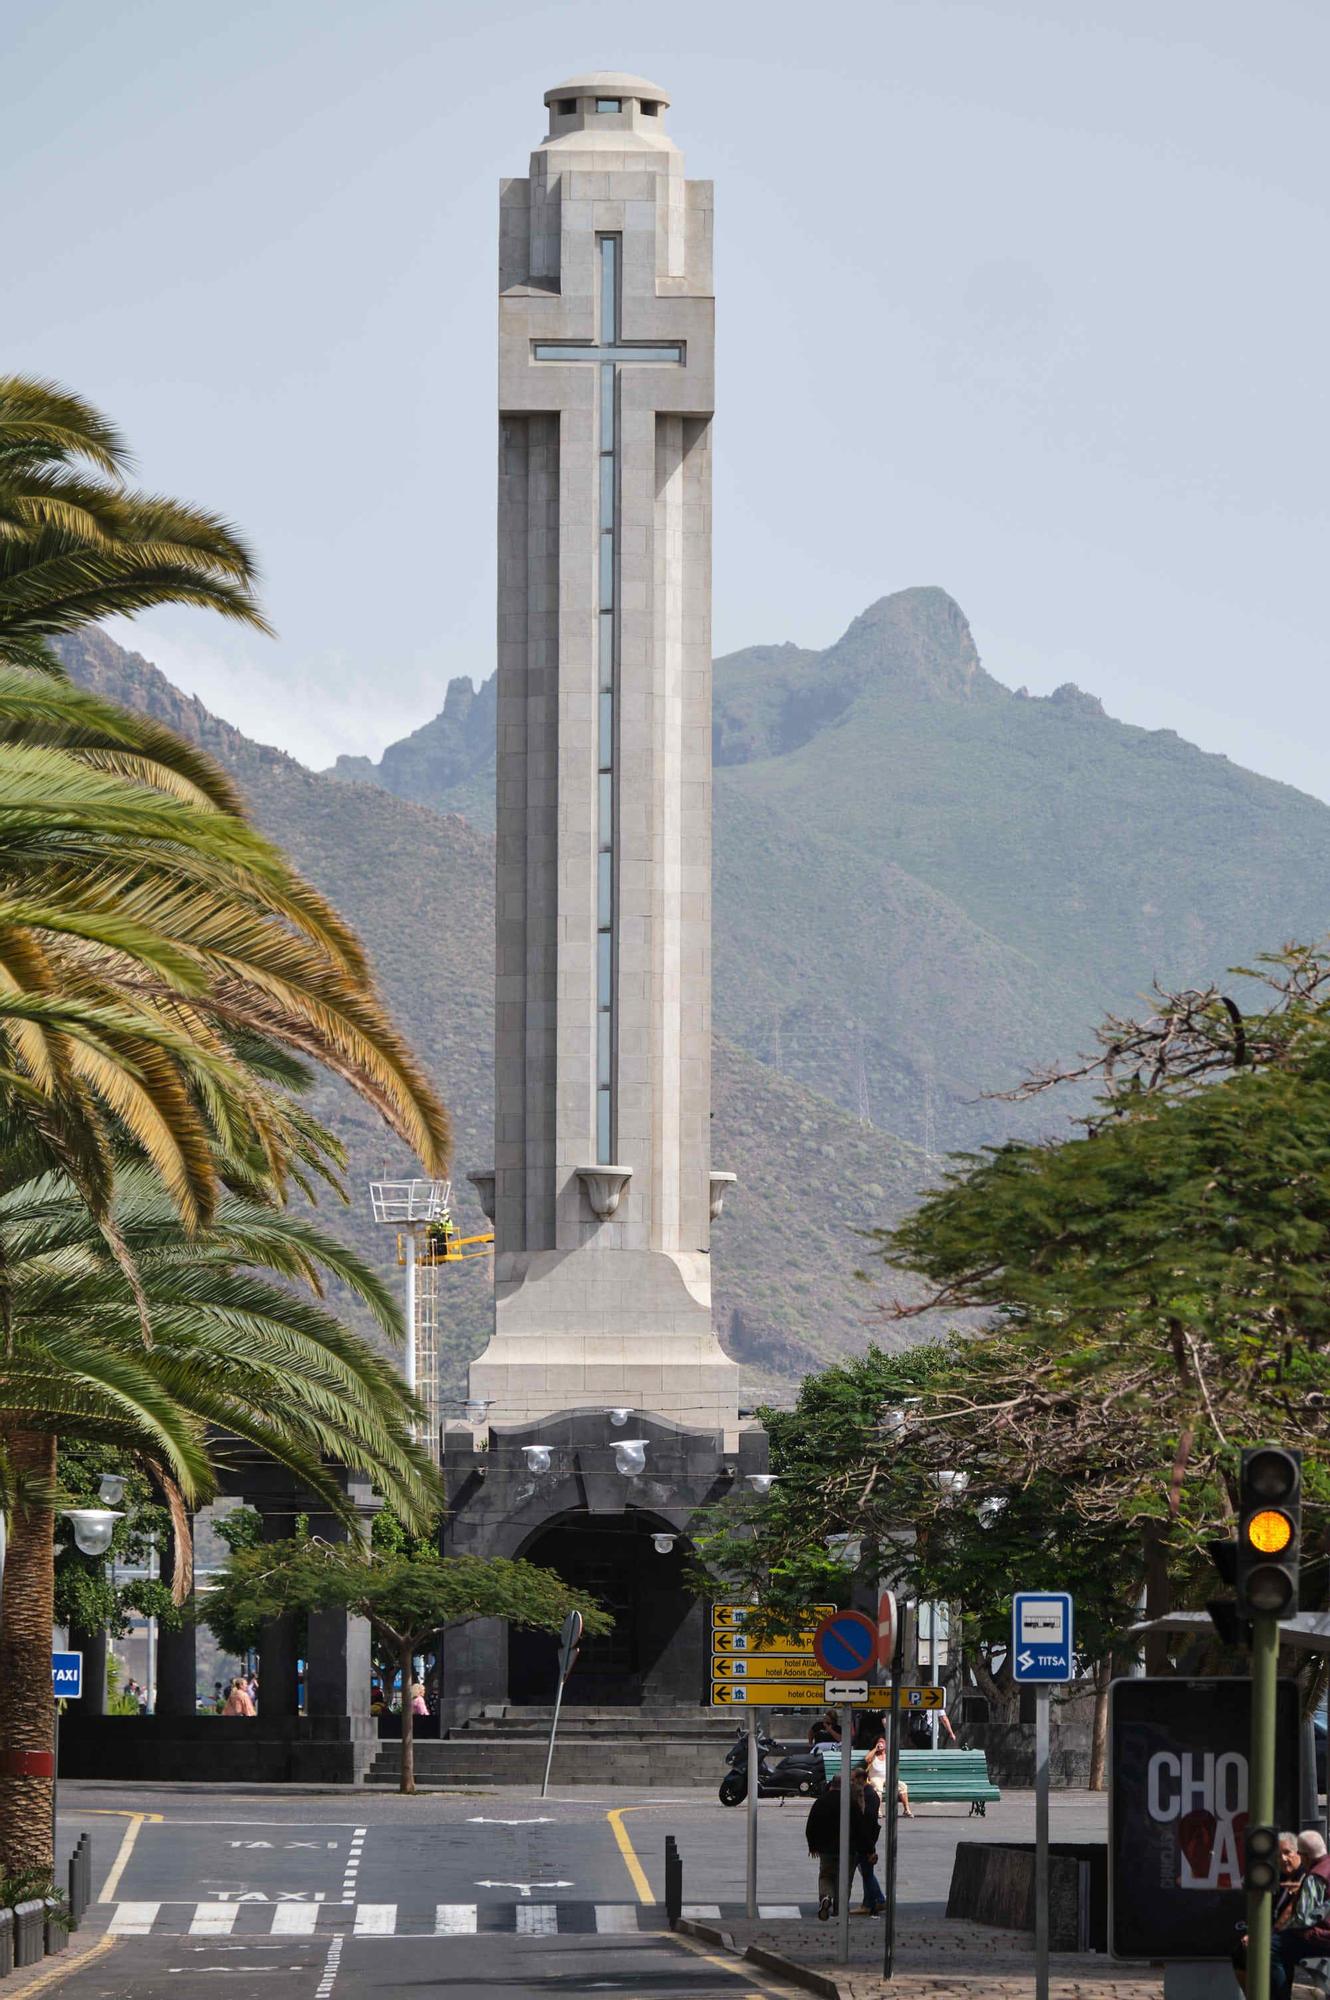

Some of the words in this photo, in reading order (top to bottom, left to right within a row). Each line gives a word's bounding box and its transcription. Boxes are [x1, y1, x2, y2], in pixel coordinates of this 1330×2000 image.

[784, 1659, 801, 1667] hotel
[1037, 1655, 1066, 1667] TITSA
[52, 1669, 78, 1681] TAXI
[766, 1668, 782, 1676] hotel
[783, 1668, 806, 1676] Adonis
[788, 1690, 804, 1698] hotel
[1147, 1751, 1249, 1822] CHO
[223, 1840, 338, 1849] TAXI
[207, 1891, 326, 1901] TAXI
